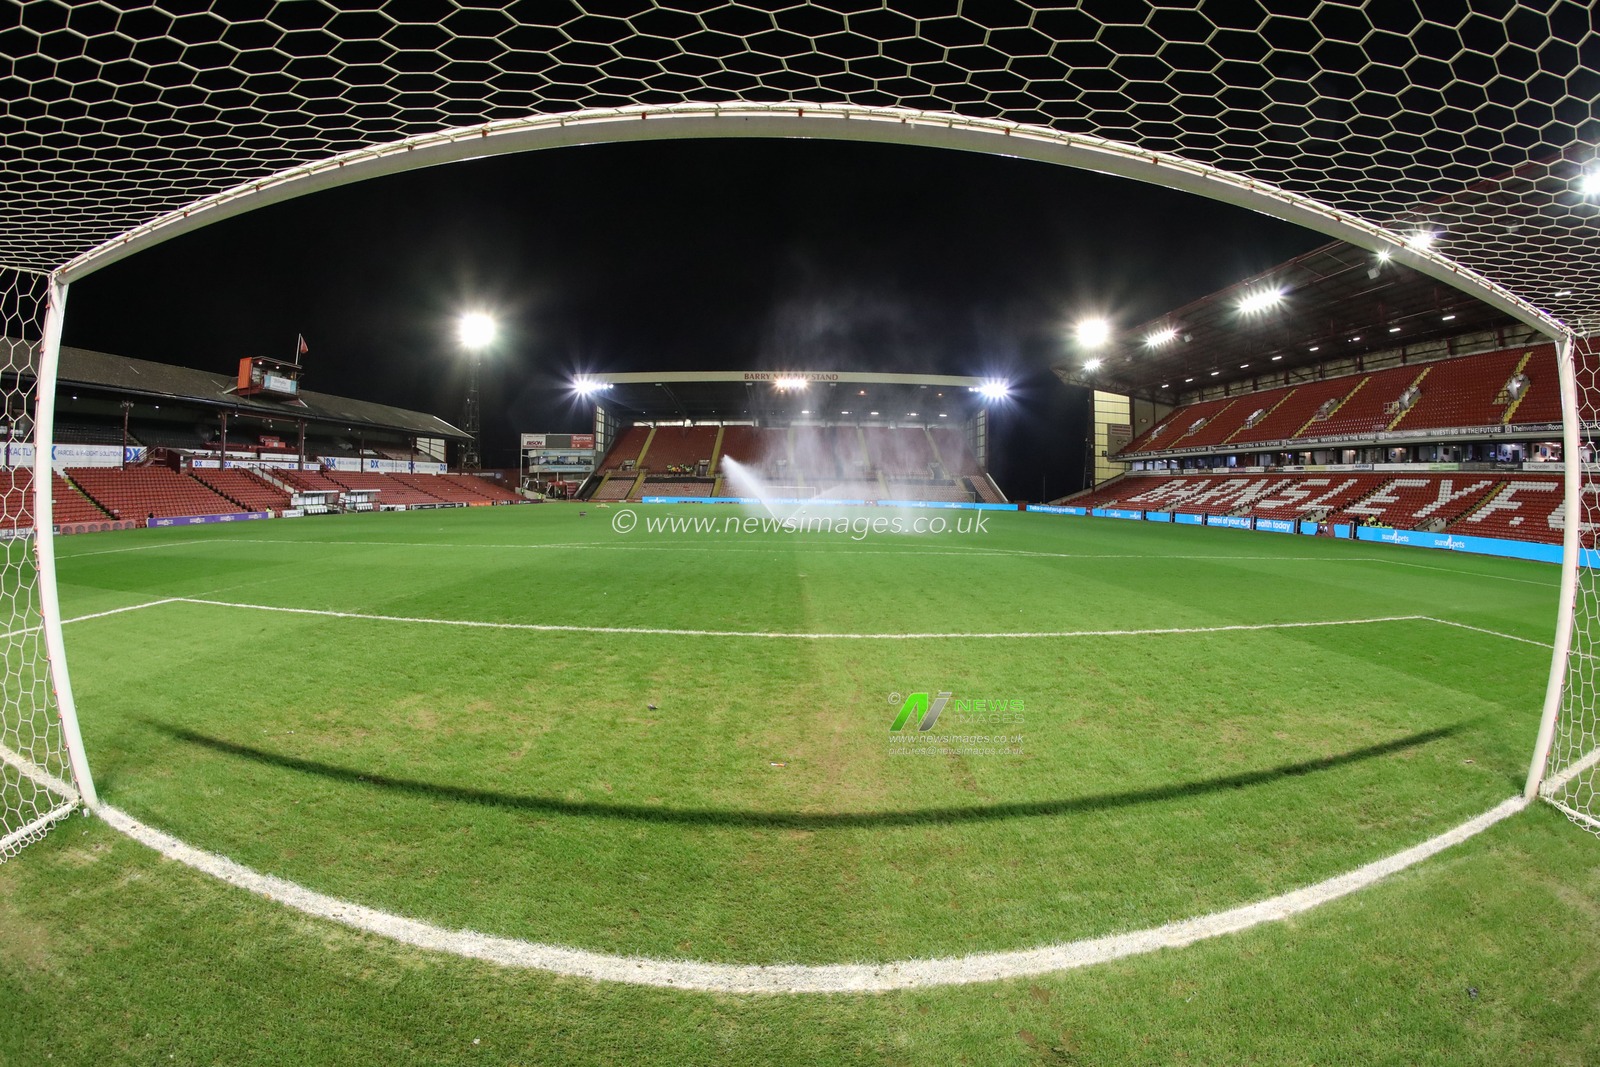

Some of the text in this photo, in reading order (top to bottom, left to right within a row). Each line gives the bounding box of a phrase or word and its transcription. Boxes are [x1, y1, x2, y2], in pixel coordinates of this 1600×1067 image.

[1431, 428, 1458, 436] INVESTING
[125, 447, 140, 463] DX
[371, 460, 379, 469] DX
[1228, 519, 1240, 527] your
[1273, 522, 1290, 532] today
